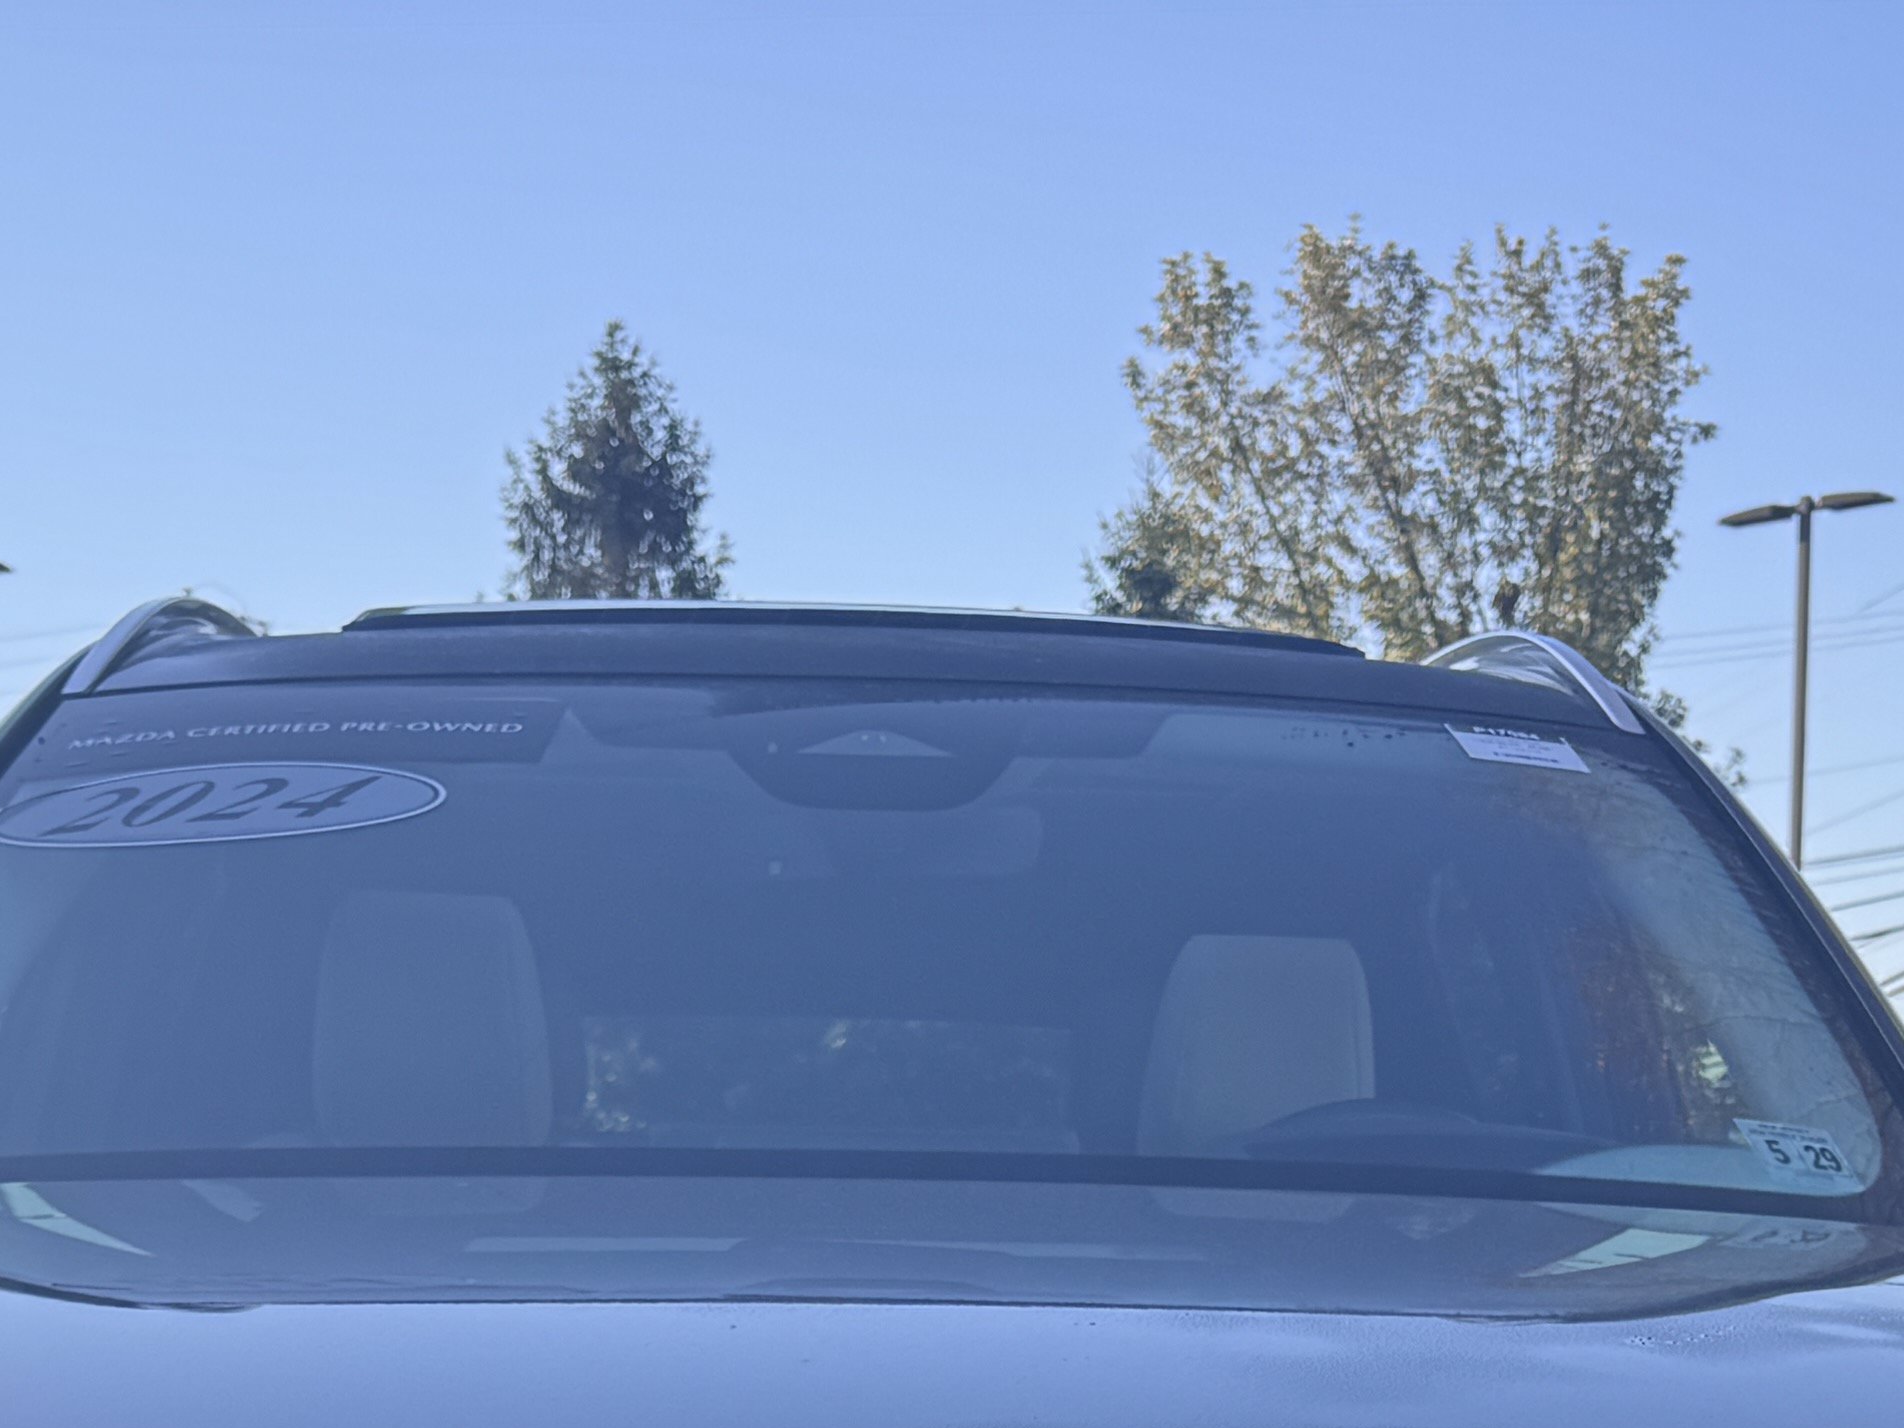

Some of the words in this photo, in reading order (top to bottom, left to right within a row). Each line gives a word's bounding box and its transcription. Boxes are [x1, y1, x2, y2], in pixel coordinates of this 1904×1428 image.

[67, 728, 177, 751] MAZDA
[186, 721, 331, 739] CERTIFIED
[340, 720, 524, 735] PRE-OWNED
[37, 774, 385, 838] 2024
[1764, 1139, 1792, 1165] 5
[1803, 1144, 1843, 1172] 29
